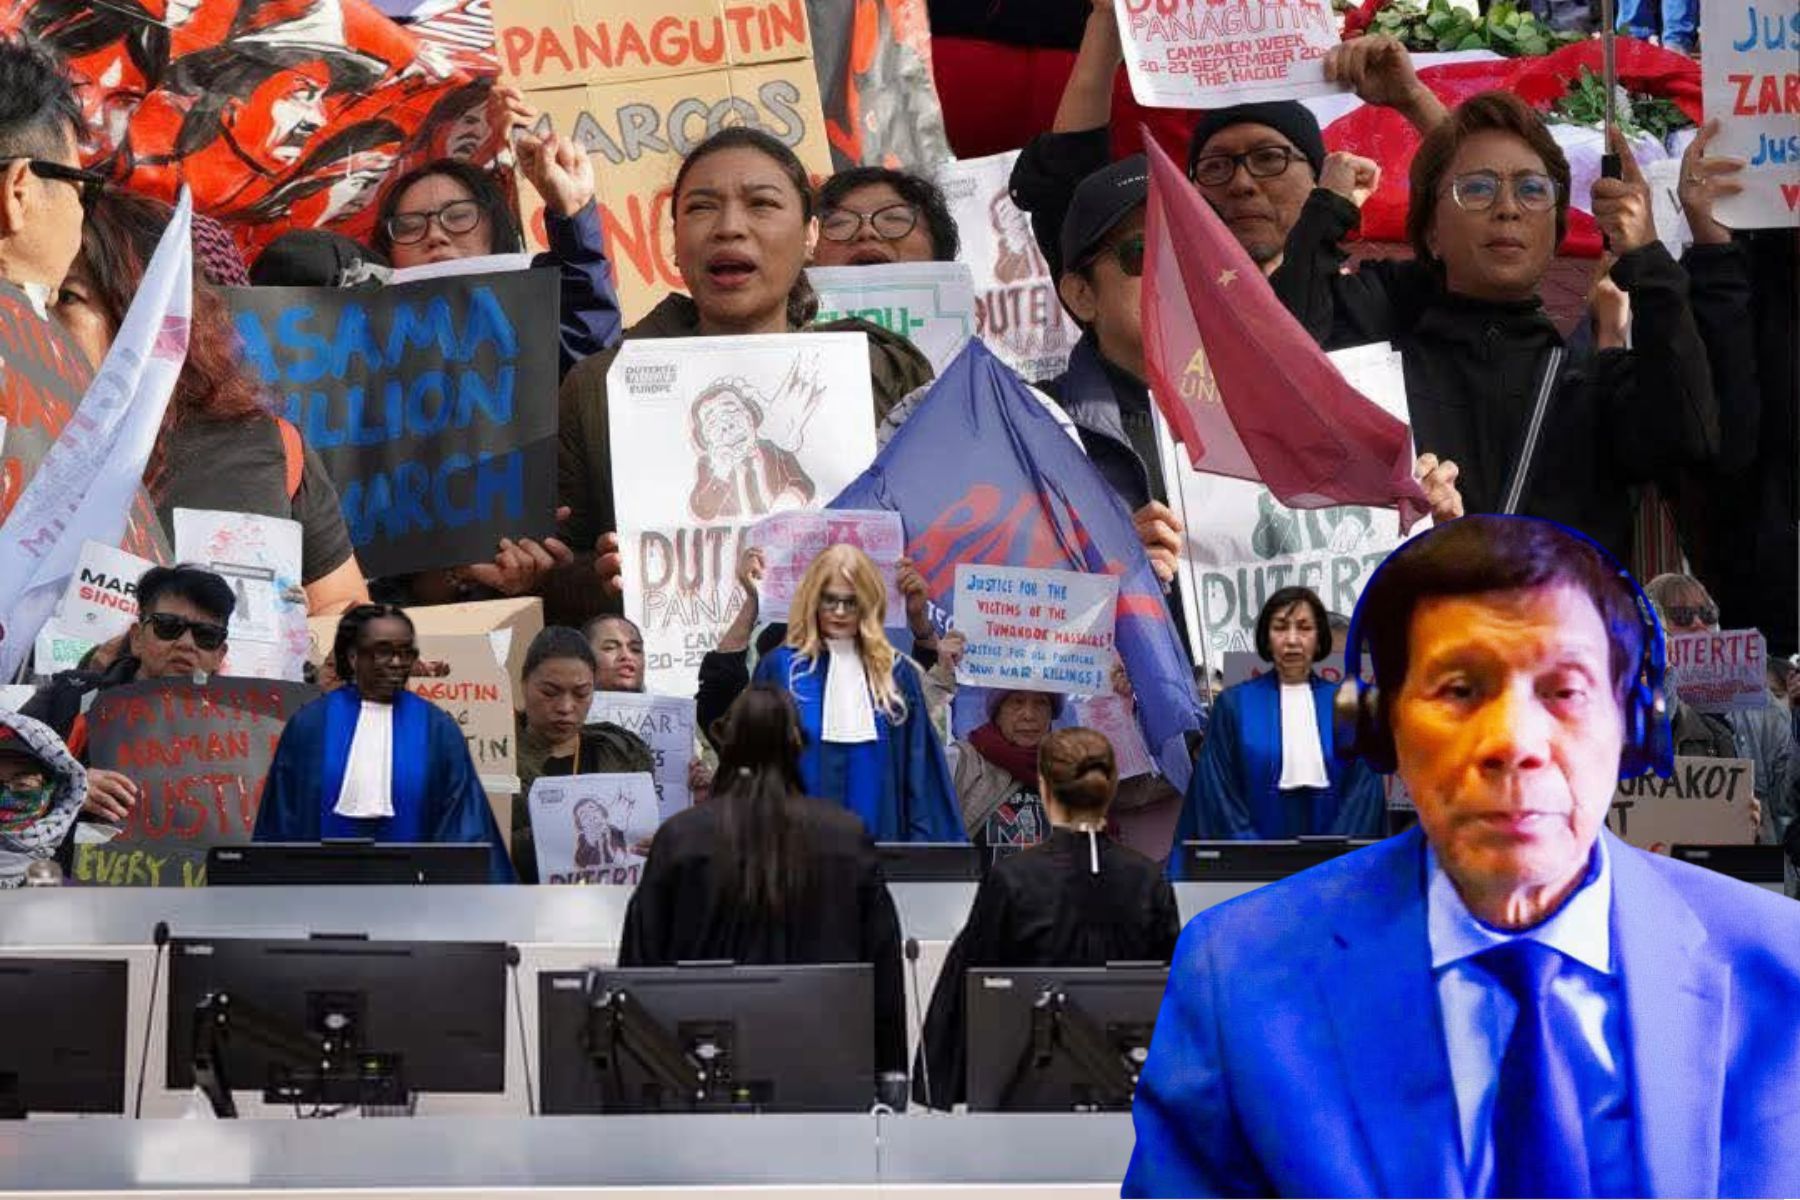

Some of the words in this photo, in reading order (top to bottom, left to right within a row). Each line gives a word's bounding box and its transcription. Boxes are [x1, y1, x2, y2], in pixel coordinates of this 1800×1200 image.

[1131, 3, 1329, 41] PANAGUTIN
[502, 1, 806, 76] PANAGUTIN
[1166, 41, 1251, 61] CAMPAIGN
[1257, 34, 1307, 53] WEEK
[1190, 49, 1295, 73] SEPTEMBER
[1194, 71, 1228, 87] THE
[1232, 63, 1289, 83] HAGUE
[967, 574, 1013, 594] JUSTICE
[1020, 580, 1039, 594] FOR
[1048, 584, 1068, 600] THE
[977, 599, 1022, 617] VICTIMS
[1047, 608, 1067, 620] THE
[617, 710, 672, 734] WAR
[75, 843, 166, 886] EVERY
